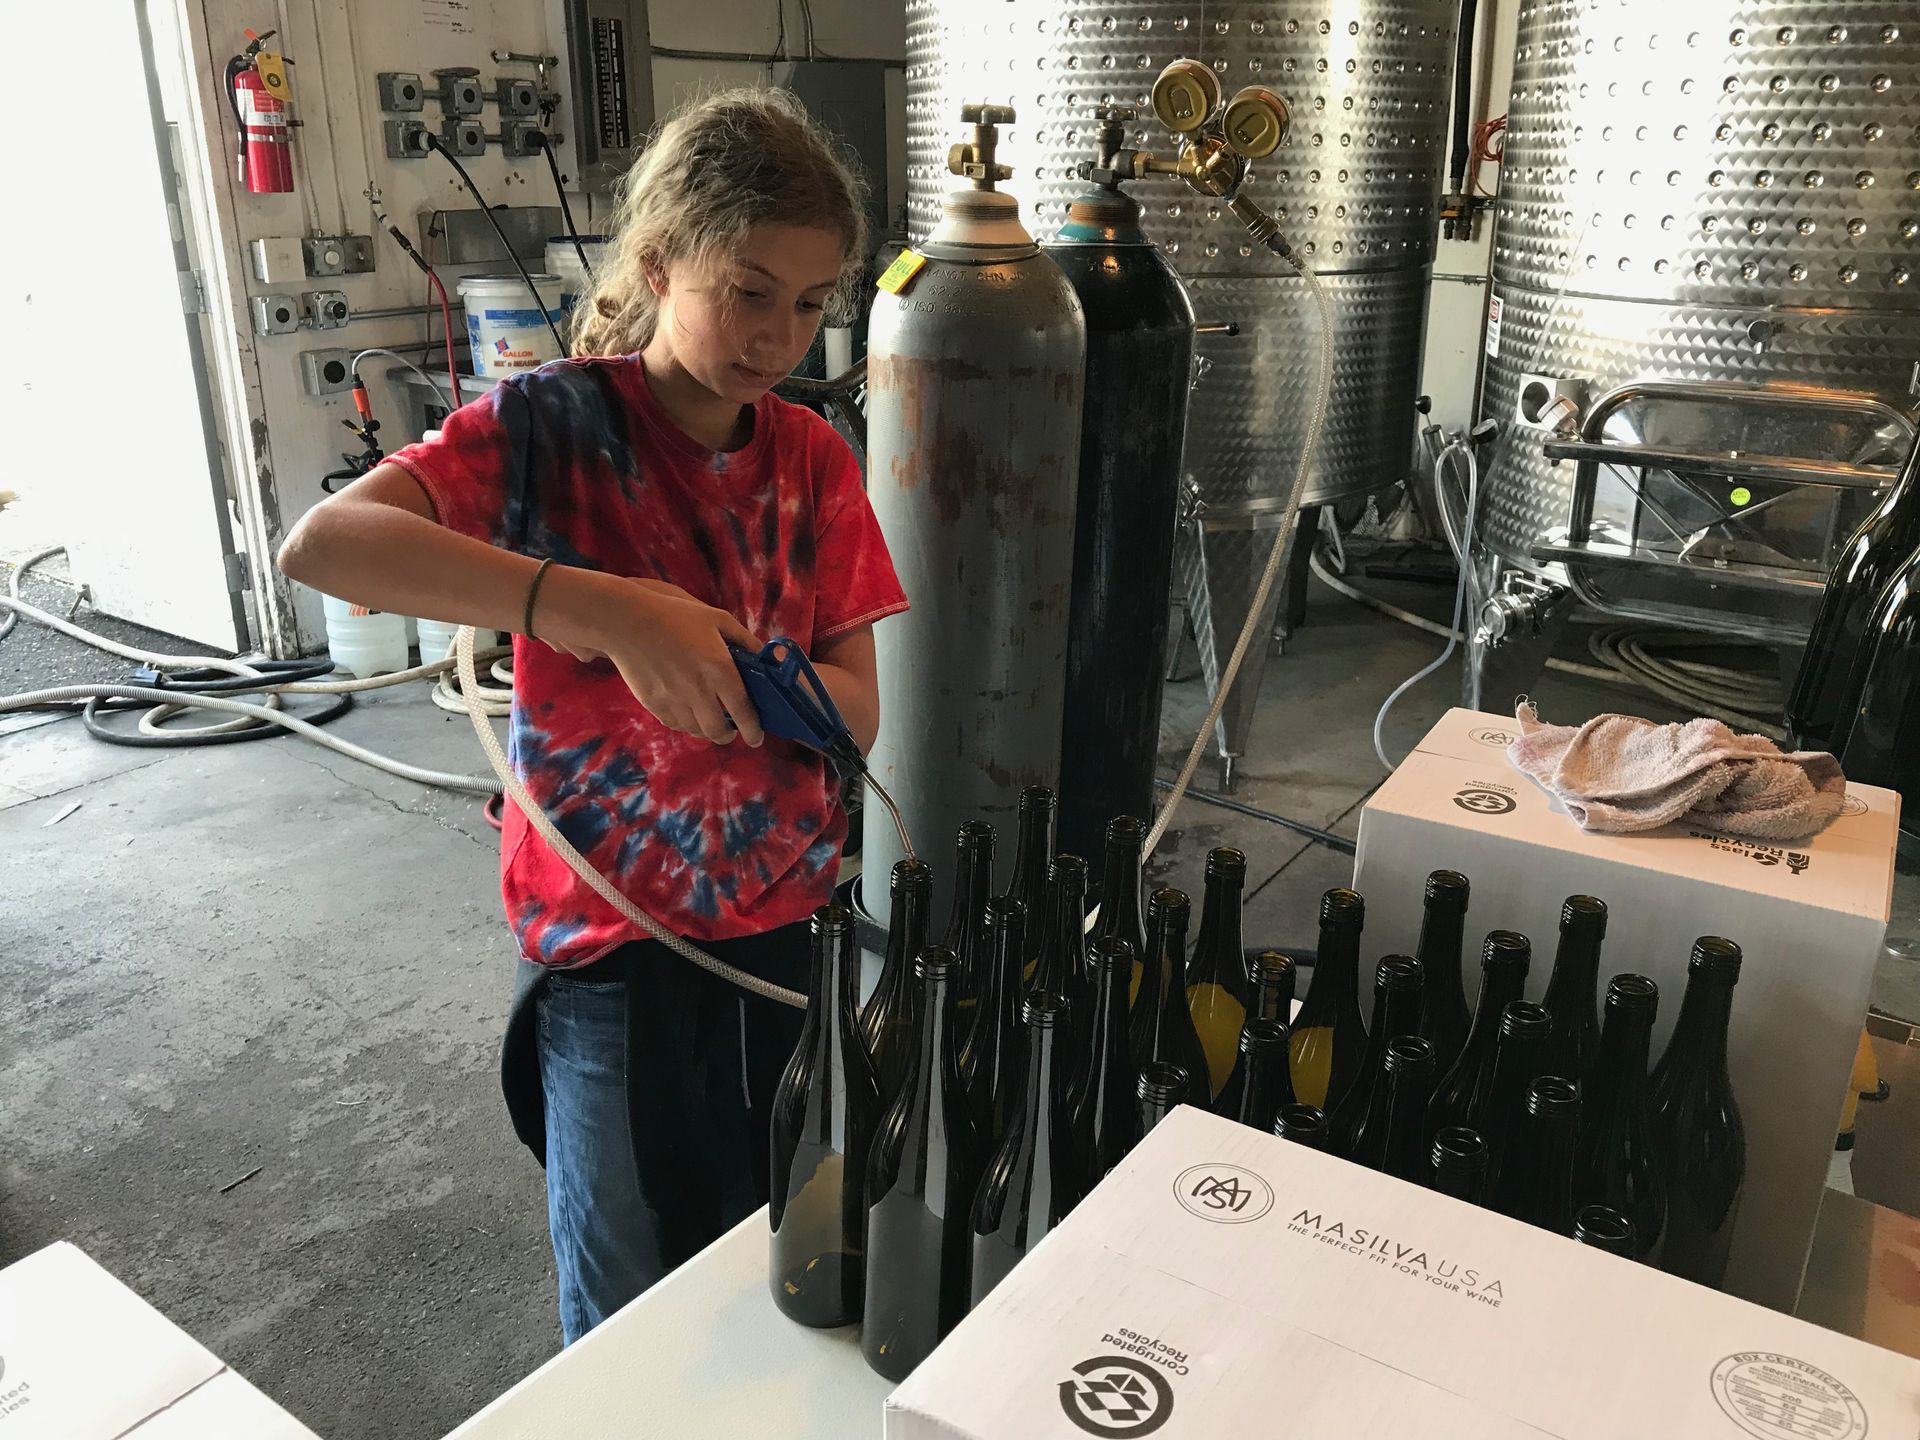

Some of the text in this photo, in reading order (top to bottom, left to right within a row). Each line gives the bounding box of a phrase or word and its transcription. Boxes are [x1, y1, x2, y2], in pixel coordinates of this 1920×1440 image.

[503, 350, 533, 358] GALLON
[1465, 782, 1517, 795] Corrugated
[1690, 831, 1783, 857] Recycles
[1287, 1223, 1501, 1308] THE PERFECT FIT FOR YOUR WINE
[1101, 1333, 1189, 1376] Corrugated
[1118, 1328, 1189, 1363] Recycles
[1733, 1354, 1762, 1364] BOX
[1766, 1355, 1855, 1402] CERTIFICATE
[1762, 1365, 1828, 1394] SINGLEWALL
